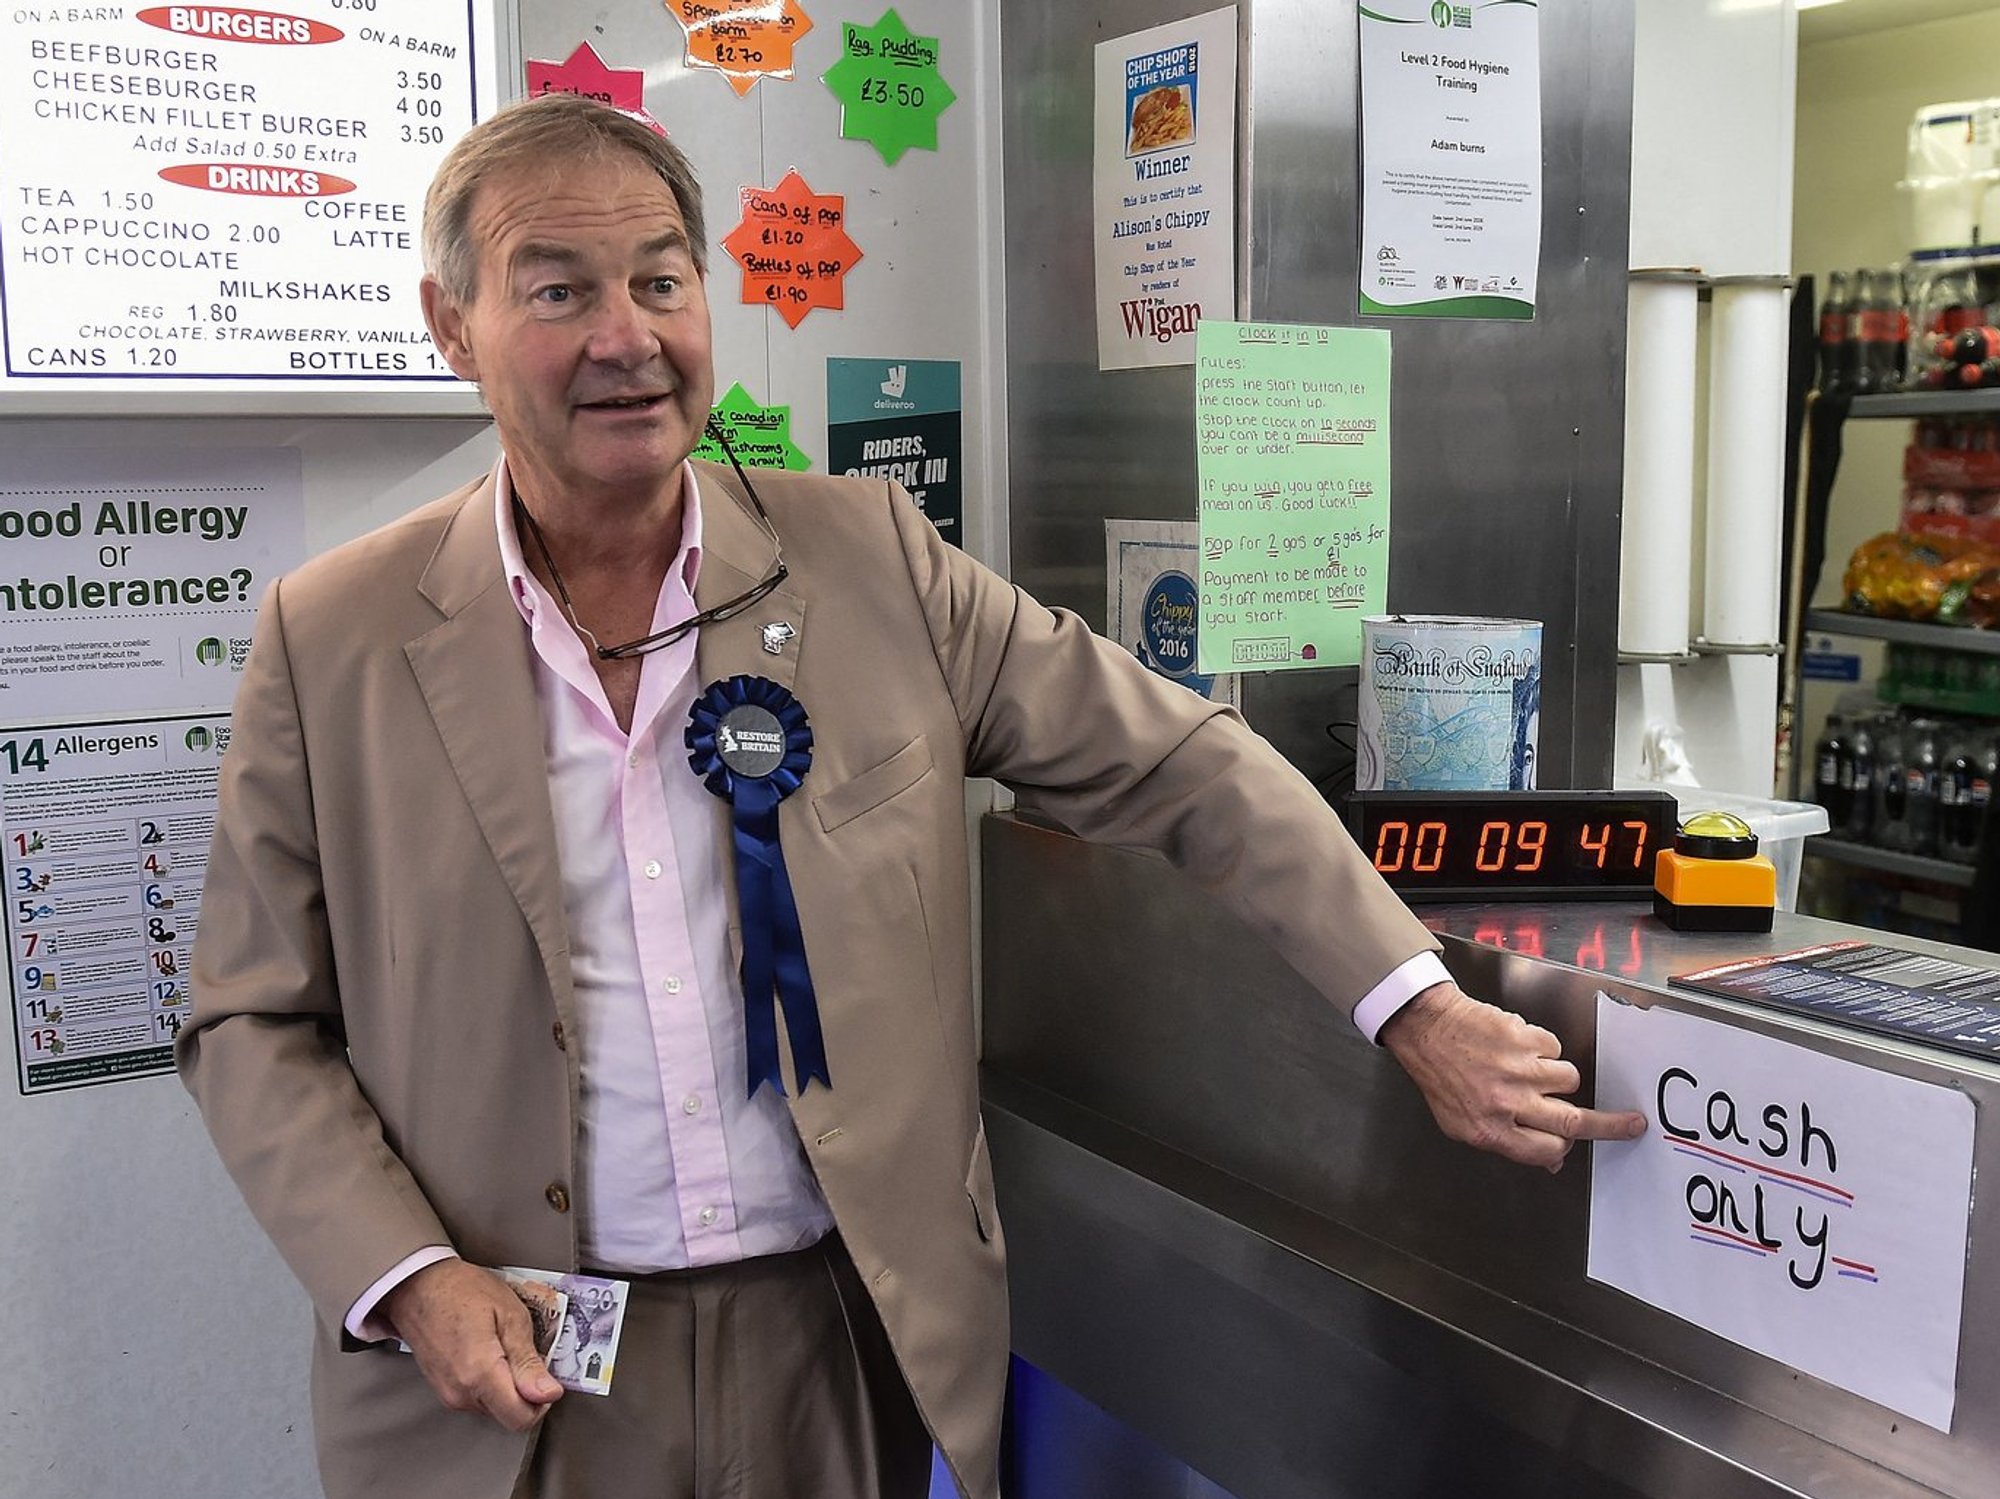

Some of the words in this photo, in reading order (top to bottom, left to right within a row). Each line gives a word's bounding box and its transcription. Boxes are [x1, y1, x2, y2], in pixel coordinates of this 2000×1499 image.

[14, 10, 41, 24] ON
[49, 9, 60, 22] A
[68, 7, 123, 22] BARM
[169, 7, 311, 43] BURGERS
[360, 27, 385, 44] ON
[389, 34, 401, 47] A
[406, 37, 456, 59] BARM
[715, 43, 763, 63] £2.70
[31, 39, 218, 72] BEEFBURGER
[396, 70, 443, 90] 3.50
[1127, 56, 1155, 76] CHIP
[1155, 48, 1188, 69] SHOP
[1188, 46, 1197, 73] 2018
[1401, 50, 1429, 66] Level
[1432, 54, 1438, 67] 2
[1440, 56, 1466, 70] Food
[1468, 59, 1510, 76] Hygiene
[33, 70, 256, 103] CHEESEBURGER
[1127, 76, 1141, 90] OF
[1141, 70, 1159, 87] THE
[1159, 64, 1186, 82] YEAR
[1435, 74, 1478, 94] Training
[861, 77, 924, 108] £3.50
[35, 99, 156, 125] CHICKEN
[167, 108, 251, 131] FILLET
[262, 114, 368, 139] BURGER
[401, 124, 444, 144] 3.50
[133, 134, 177, 153] Add
[185, 137, 246, 157] Salad
[253, 141, 297, 160] 0.50
[304, 144, 357, 164] Extra
[1430, 138, 1458, 151] Adam
[1459, 141, 1486, 154] burns
[207, 165, 320, 196] DRINKS
[1134, 154, 1191, 182] Winner
[19, 186, 75, 207] TEA
[102, 190, 154, 212] 1.50
[304, 200, 407, 222] COFFEE
[1123, 196, 1138, 209] This
[1159, 187, 1185, 202] certify
[1187, 184, 1203, 195] that
[750, 196, 788, 217] Cans
[793, 206, 811, 225] of
[817, 208, 841, 227] pop
[1112, 214, 1162, 240] Alison's
[1165, 209, 1211, 231] Chippy
[21, 216, 210, 241] CAPPUCCINO
[228, 223, 281, 244] 2.00
[333, 229, 412, 250] LATTE
[761, 228, 804, 245] £1.20
[23, 246, 74, 265] HOT
[85, 247, 240, 271] CHOCOLATE
[741, 252, 792, 272] Bottles
[796, 262, 814, 280] of
[219, 280, 391, 302] MILKSHAKES
[765, 284, 808, 304] £1.90
[128, 305, 164, 320] REG
[187, 303, 237, 323] 1.80
[1119, 297, 1203, 344] Wigan
[27, 347, 107, 366] CANS
[127, 347, 177, 367] 1.20
[290, 351, 408, 371] BOTTLES
[1201, 376, 1235, 393] press
[1243, 378, 1262, 391] the
[874, 399, 915, 410] deliveroo
[1236, 414, 1258, 427] the
[1300, 418, 1316, 429] on
[862, 435, 927, 461] RIDERS,
[923, 457, 948, 485] IN
[1202, 499, 1235, 512] meal
[1238, 500, 1253, 511] on
[1281, 498, 1314, 512] Good
[0, 500, 82, 539] ood
[93, 500, 248, 542] Allergy
[1204, 536, 1233, 554] 50p
[1239, 535, 1262, 550] for
[1267, 533, 1277, 550] 2
[1313, 536, 1326, 548] or
[1332, 532, 1341, 546] 5
[1367, 523, 1386, 545] for
[99, 545, 132, 568] or
[0, 567, 253, 612] ntolerance?
[1203, 569, 1269, 591] Payment
[1275, 570, 1289, 583] to
[1294, 567, 1310, 581] be
[1313, 562, 1349, 580] made
[1354, 563, 1368, 577] to
[1151, 592, 1194, 622] Chippy
[1202, 594, 1212, 606] a
[1262, 588, 1319, 605] member
[1326, 582, 1365, 600] before
[1206, 612, 1236, 630] you
[1, 656, 29, 665] please
[102, 650, 126, 659] about
[1158, 638, 1189, 659] 2016
[1373, 640, 1441, 678] Bank
[1443, 656, 1466, 686] of
[1463, 645, 1533, 687] England
[736, 731, 781, 743] RESTORE
[741, 742, 781, 753] BRITAIN
[0, 737, 50, 775] 14
[54, 733, 159, 757] Allergens
[14, 833, 27, 857] 1
[1374, 821, 1448, 873] 00
[1475, 821, 1548, 873] 09
[1579, 820, 1649, 869] 47
[16, 867, 33, 890] 3
[19, 899, 34, 924] 5
[21, 933, 38, 958] 7
[25, 966, 41, 990] 9
[1656, 1066, 1838, 1173] Cash
